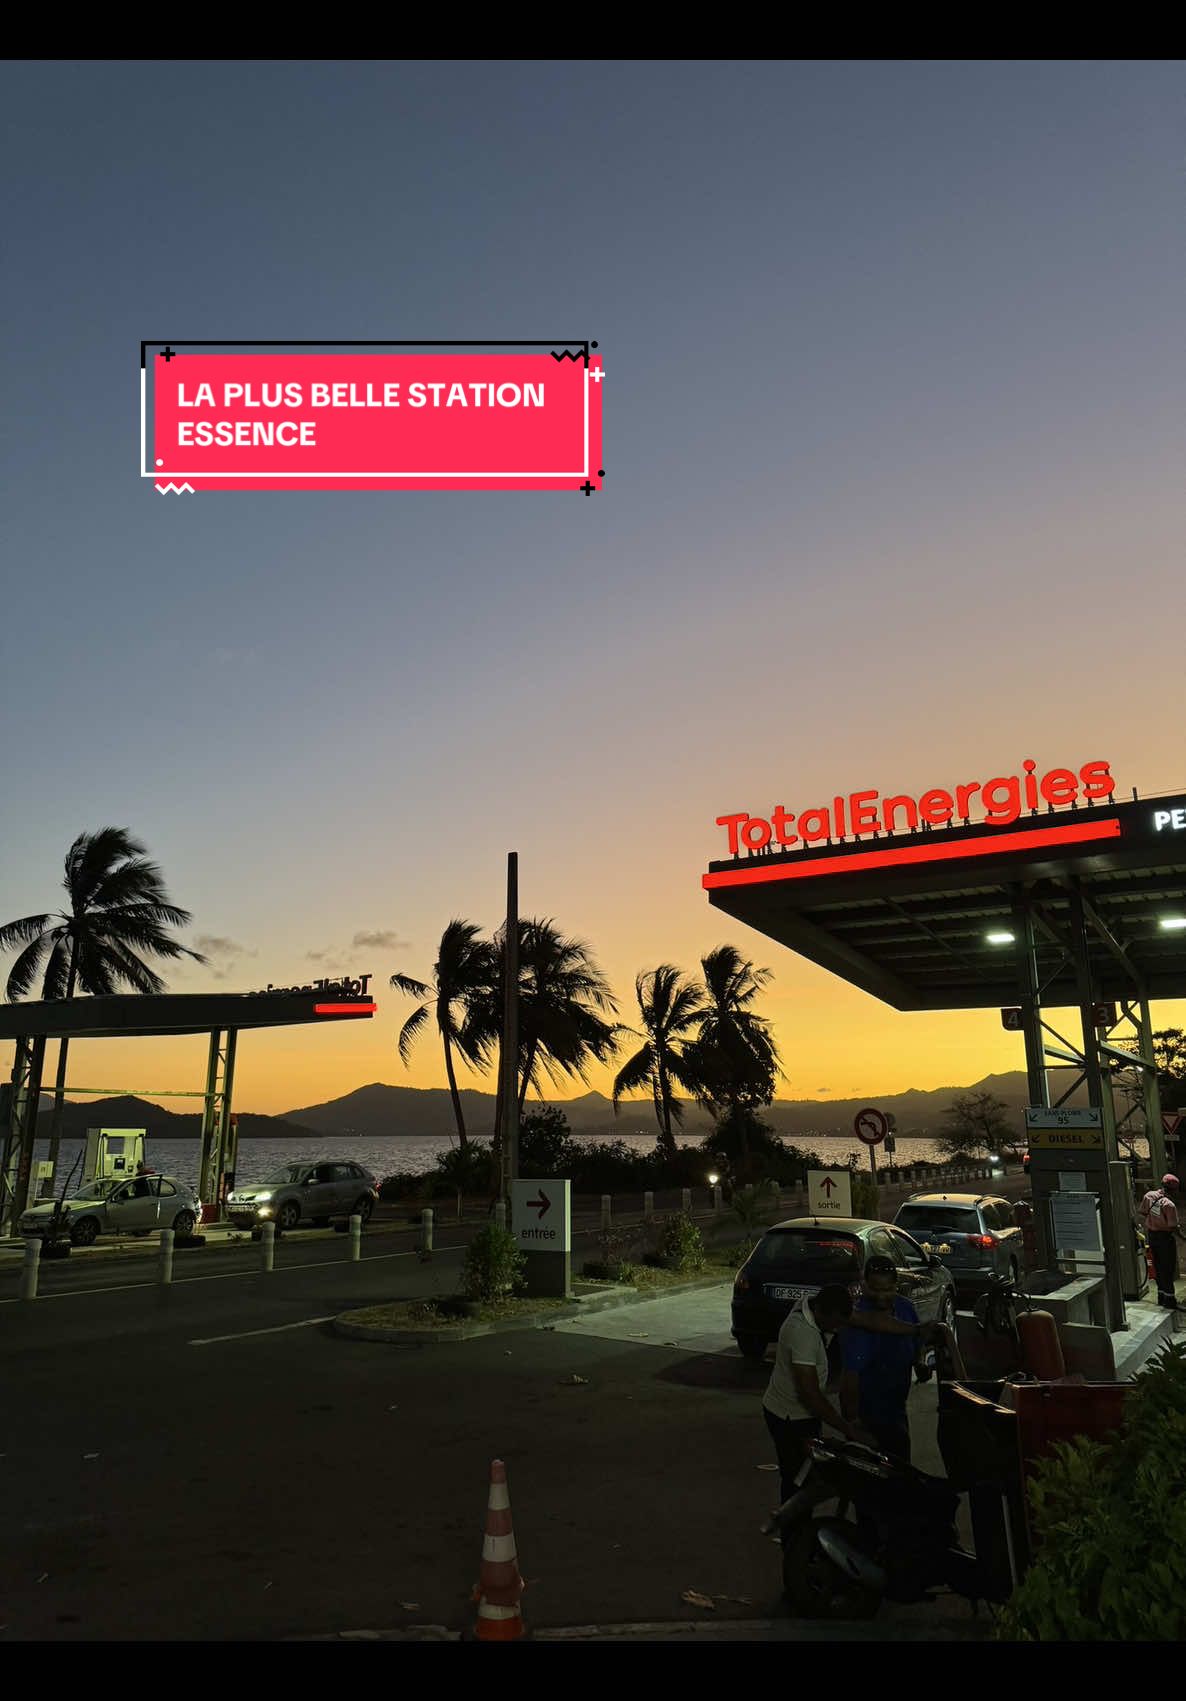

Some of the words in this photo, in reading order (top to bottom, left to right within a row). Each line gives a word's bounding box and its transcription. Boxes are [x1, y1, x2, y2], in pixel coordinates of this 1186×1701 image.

[716, 759, 1116, 855] TotalEnergies
[1154, 808, 1186, 831] PE
[1007, 1010, 1019, 1028] 4
[1096, 1007, 1110, 1025] 3
[1057, 1116, 1070, 1125] 95
[1048, 1134, 1084, 1144] DIESEL
[817, 1200, 841, 1210] sortie
[521, 1226, 556, 1240] entrée
